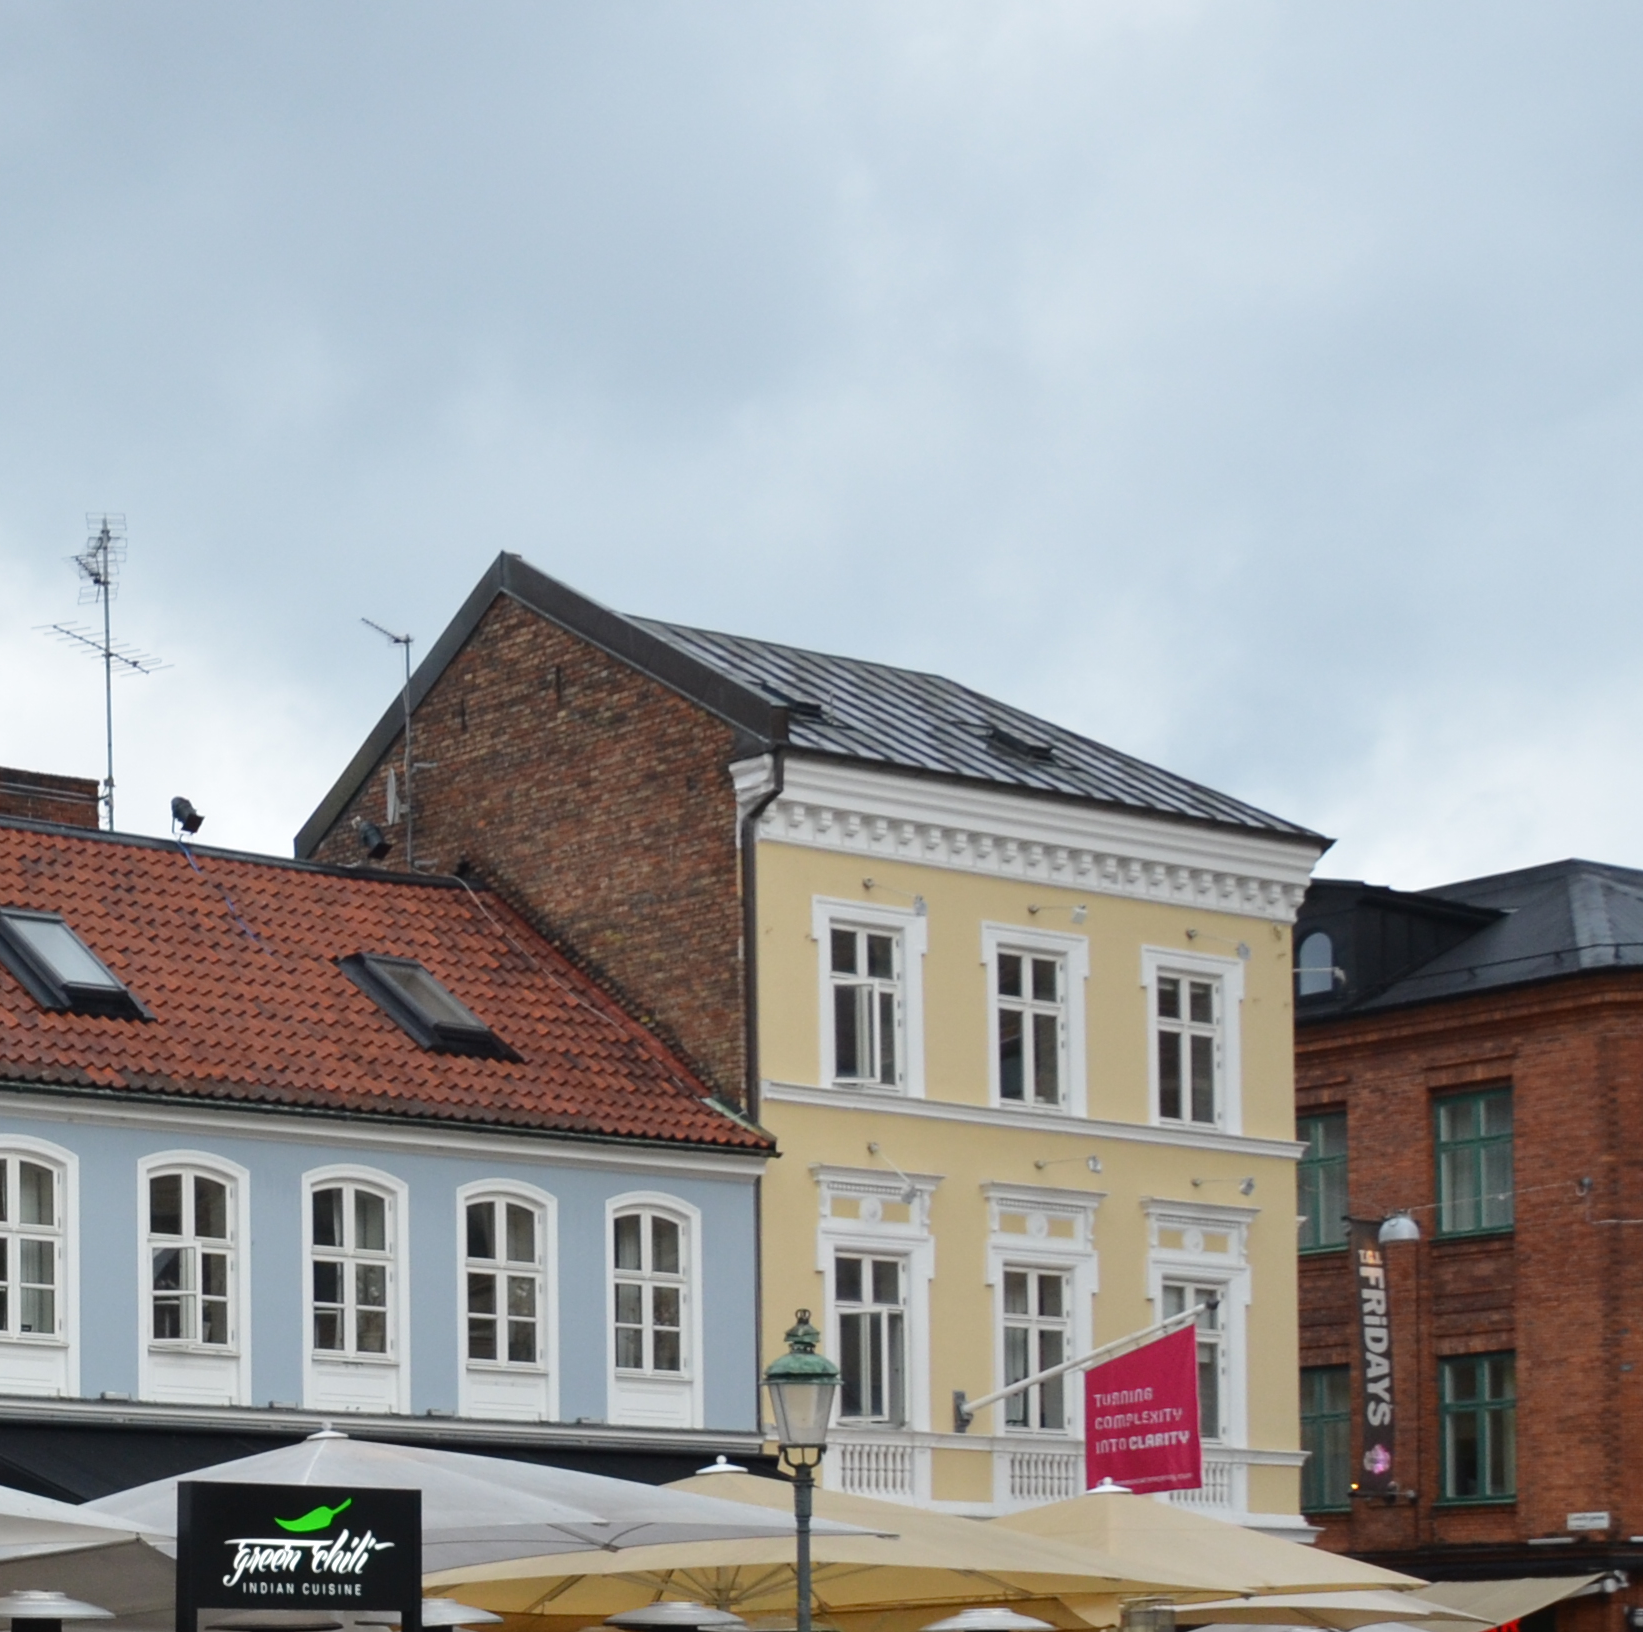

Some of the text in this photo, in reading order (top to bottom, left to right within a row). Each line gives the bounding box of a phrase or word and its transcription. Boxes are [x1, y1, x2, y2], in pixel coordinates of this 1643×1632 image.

[1128, 1430, 1191, 1451] CLARITY
[222, 1528, 395, 1587] green chili
[242, 1582, 363, 1597] INDIAN CUISINE
